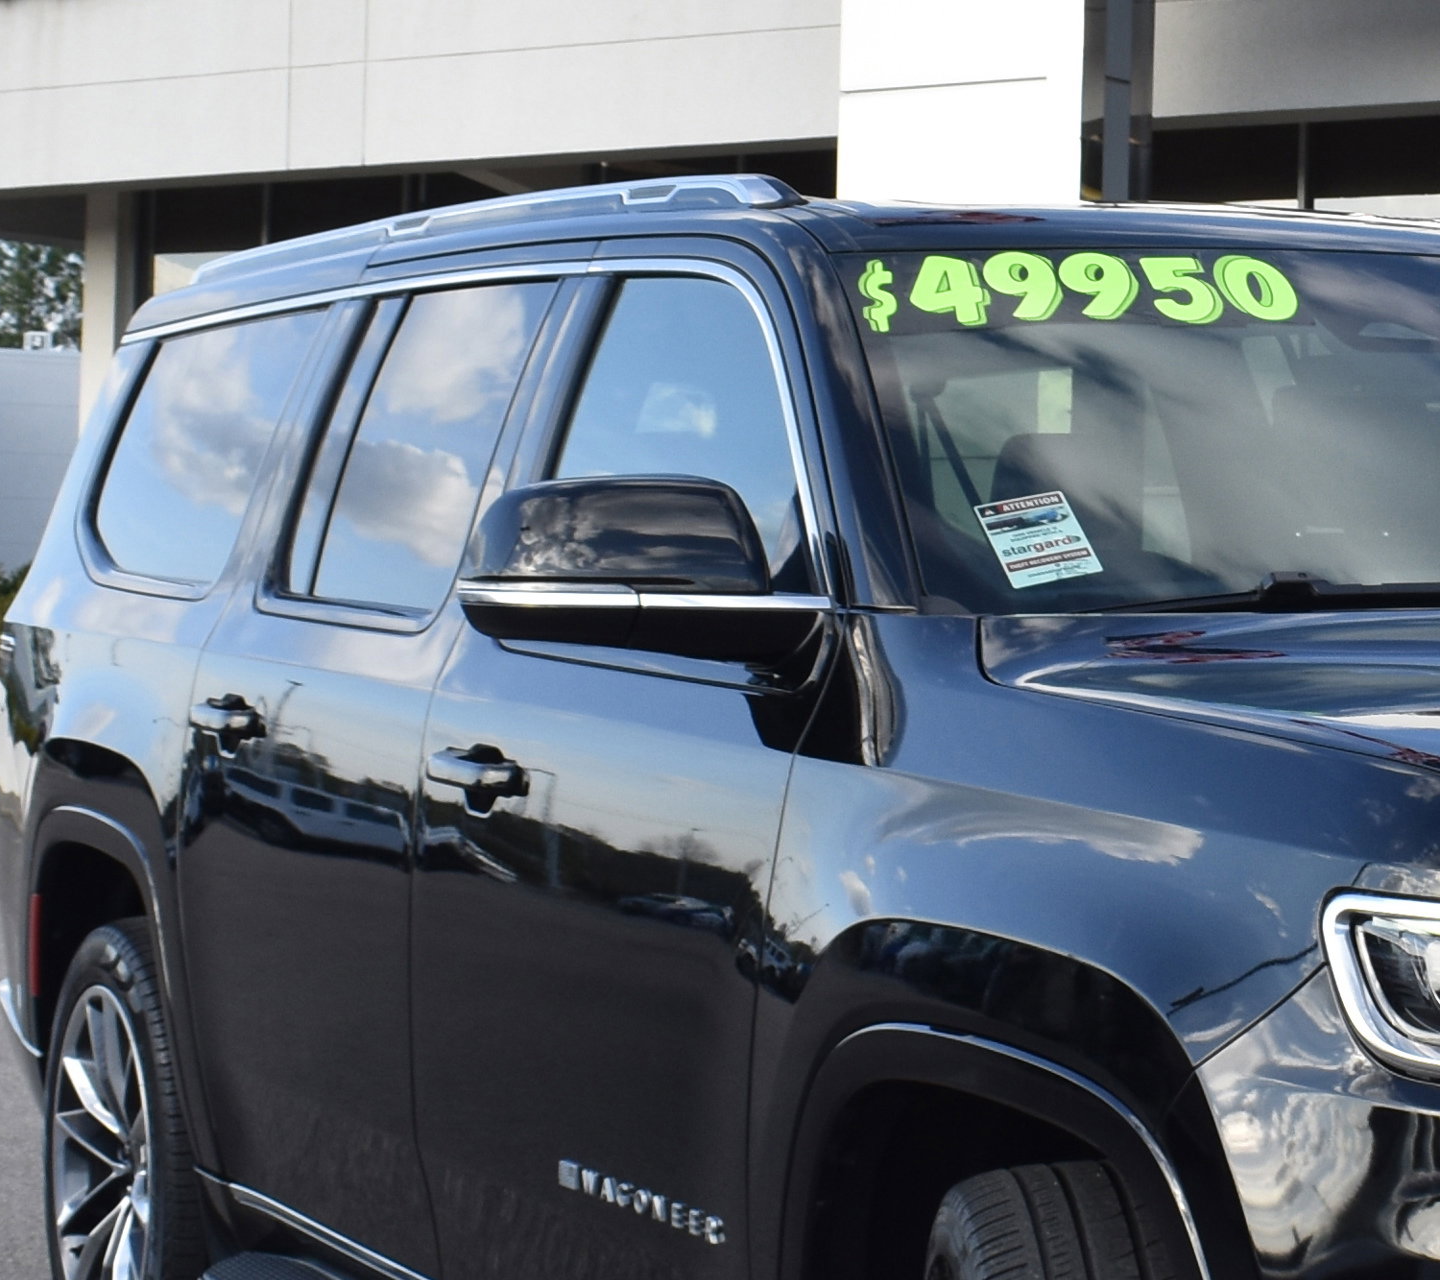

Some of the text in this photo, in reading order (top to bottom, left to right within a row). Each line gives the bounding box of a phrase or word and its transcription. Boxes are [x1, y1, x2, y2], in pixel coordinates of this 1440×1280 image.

[858, 250, 1299, 333] $49950
[1002, 495, 1060, 513] ATTENTION
[1002, 535, 1072, 557] stargard
[581, 1169, 726, 1245] WAGONEER
